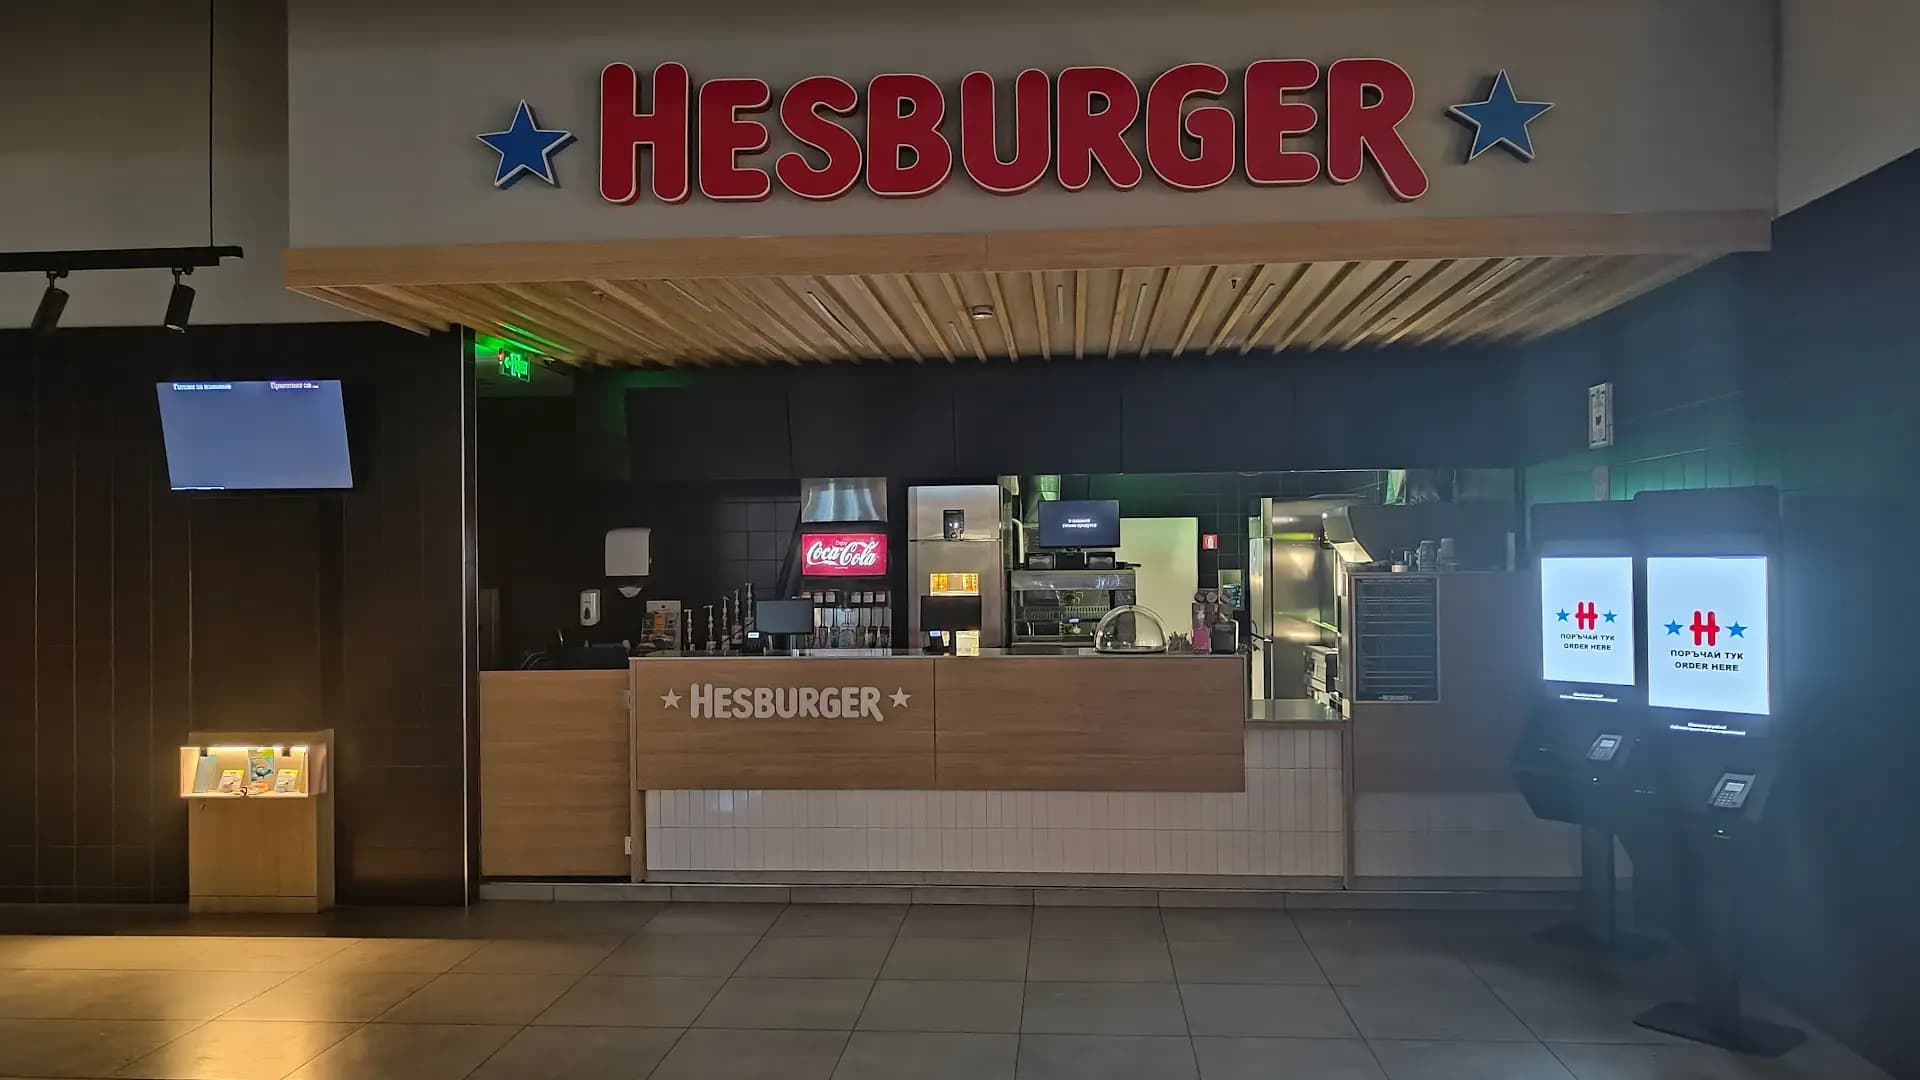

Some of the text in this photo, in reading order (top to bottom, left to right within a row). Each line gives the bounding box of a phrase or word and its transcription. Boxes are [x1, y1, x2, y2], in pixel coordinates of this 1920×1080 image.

[600, 58, 1429, 204] HESBURGER
[806, 540, 879, 566] Coca-Cola
[1560, 633, 1598, 641] ПОРЪЧАЙ
[1563, 642, 1589, 650] ORDER
[1670, 649, 1744, 660] ПОРЪЧАЙ ТУК
[1674, 661, 1740, 672] ORDER HERE
[690, 683, 884, 722] HESBURGER
